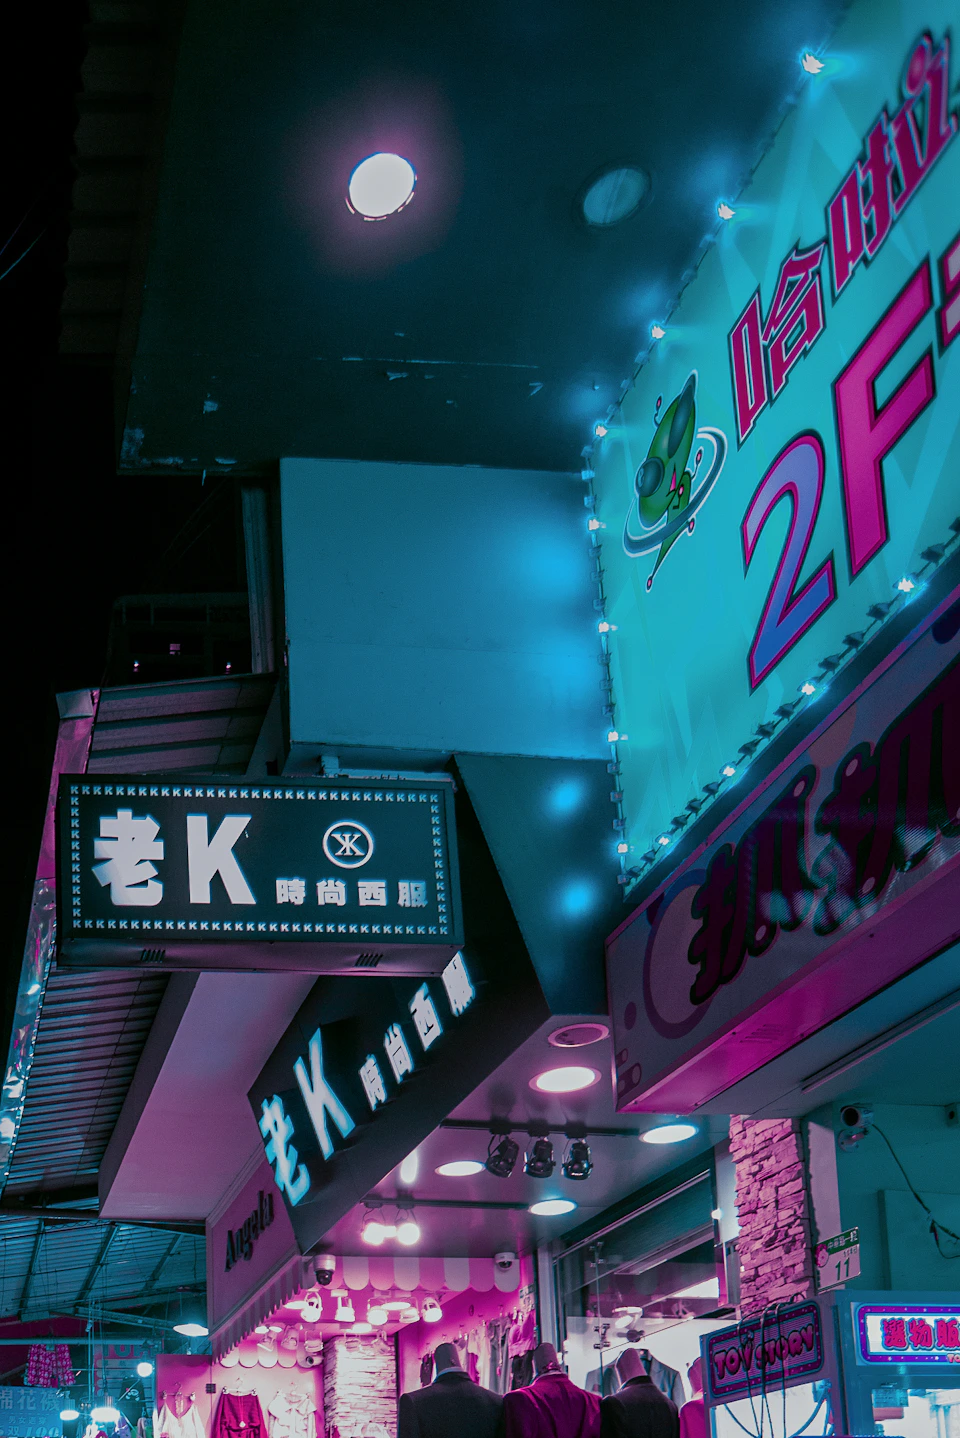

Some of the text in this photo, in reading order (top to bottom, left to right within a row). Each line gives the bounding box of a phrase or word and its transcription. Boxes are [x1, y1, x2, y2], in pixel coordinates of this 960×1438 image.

[741, 252, 960, 693] 2F
[91, 808, 259, 907] 老K
[274, 878, 429, 909] 時尚西服
[258, 1027, 355, 1206] 老K
[224, 1190, 275, 1273] Angela
[835, 1257, 850, 1281] 11
[713, 1323, 814, 1380] TOY STORY
